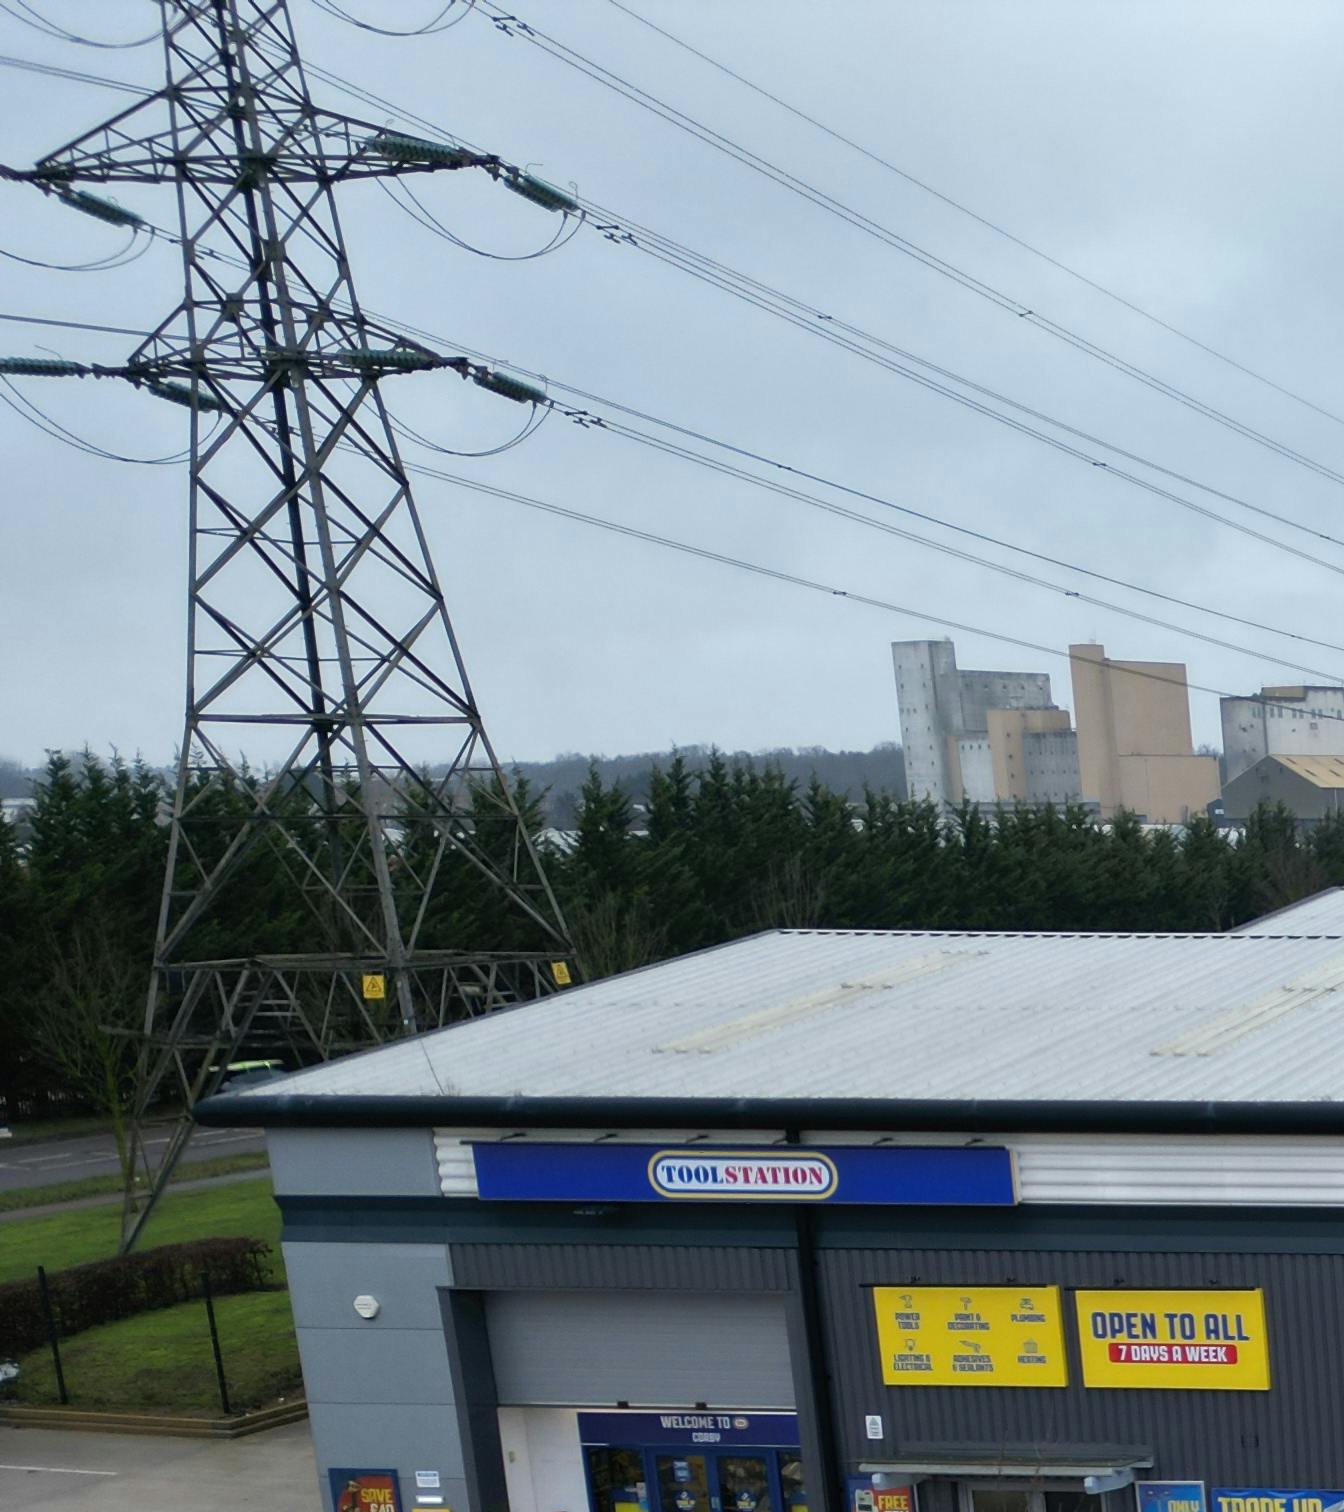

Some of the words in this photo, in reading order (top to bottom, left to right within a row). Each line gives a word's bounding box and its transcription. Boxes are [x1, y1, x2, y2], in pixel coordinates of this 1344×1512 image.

[661, 1165, 823, 1185] TOOLSTATION
[1091, 1311, 1157, 1339] OPEN
[1164, 1313, 1196, 1340] TO
[1204, 1314, 1250, 1341] ALL
[1118, 1345, 1127, 1361] 7
[1131, 1345, 1168, 1362] DAYS
[1172, 1346, 1180, 1361] A
[1185, 1346, 1228, 1362] WEEK
[660, 1416, 714, 1429] WELCOME
[717, 1416, 731, 1429] TO
[361, 1488, 394, 1503] SAVE
[877, 1495, 908, 1510] FREE
